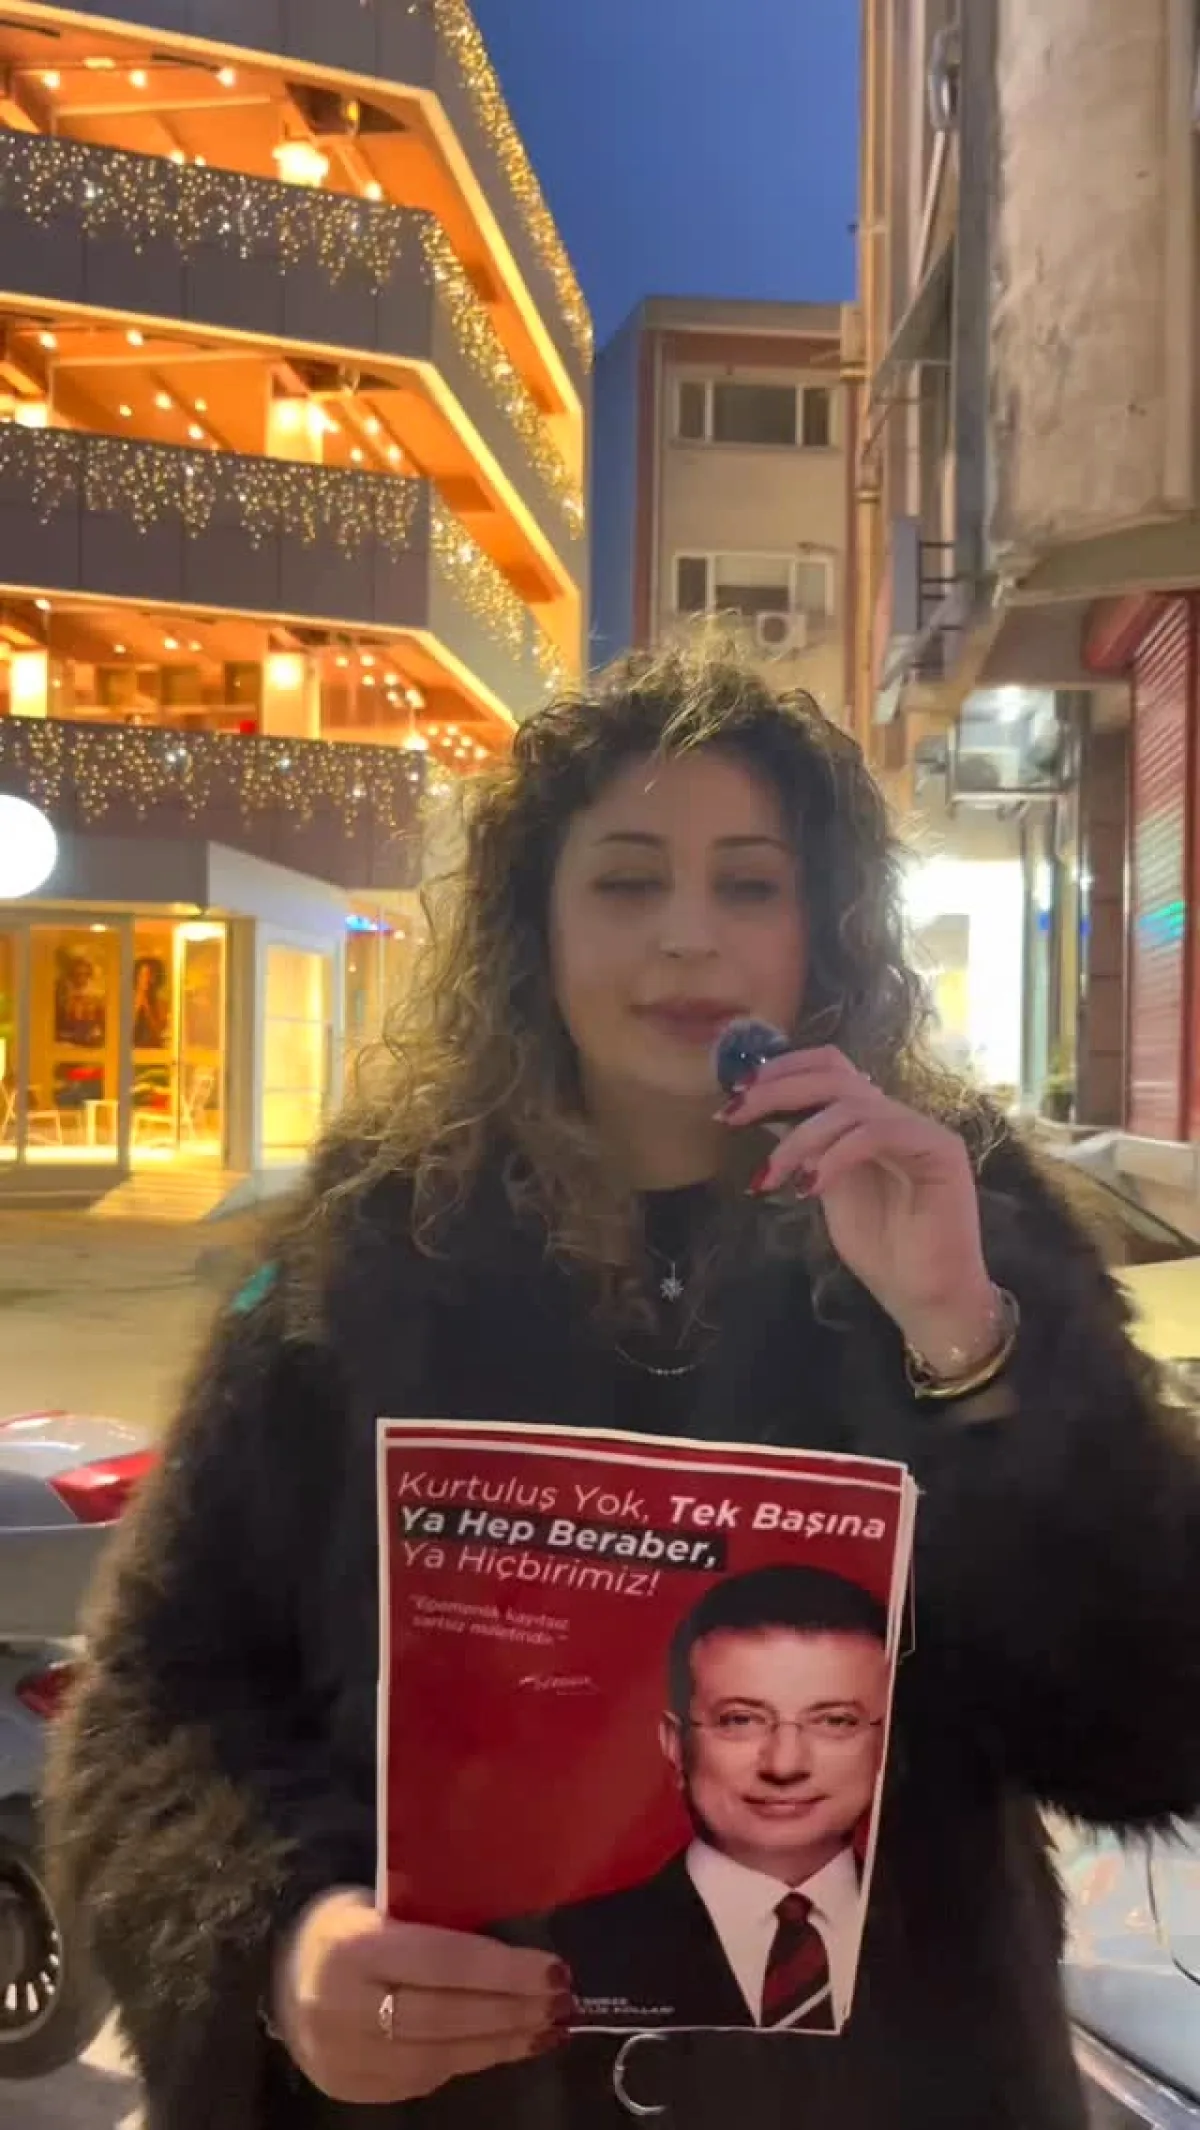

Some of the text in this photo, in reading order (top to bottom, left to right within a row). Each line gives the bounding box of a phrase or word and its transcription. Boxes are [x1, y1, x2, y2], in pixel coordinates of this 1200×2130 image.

[397, 1471, 886, 1540] Kurtuluş Yok, Tek Başına
[401, 1505, 717, 1569] Ya Hep Beraber,
[403, 1541, 661, 1597] Ya Hiçbirimiz!
